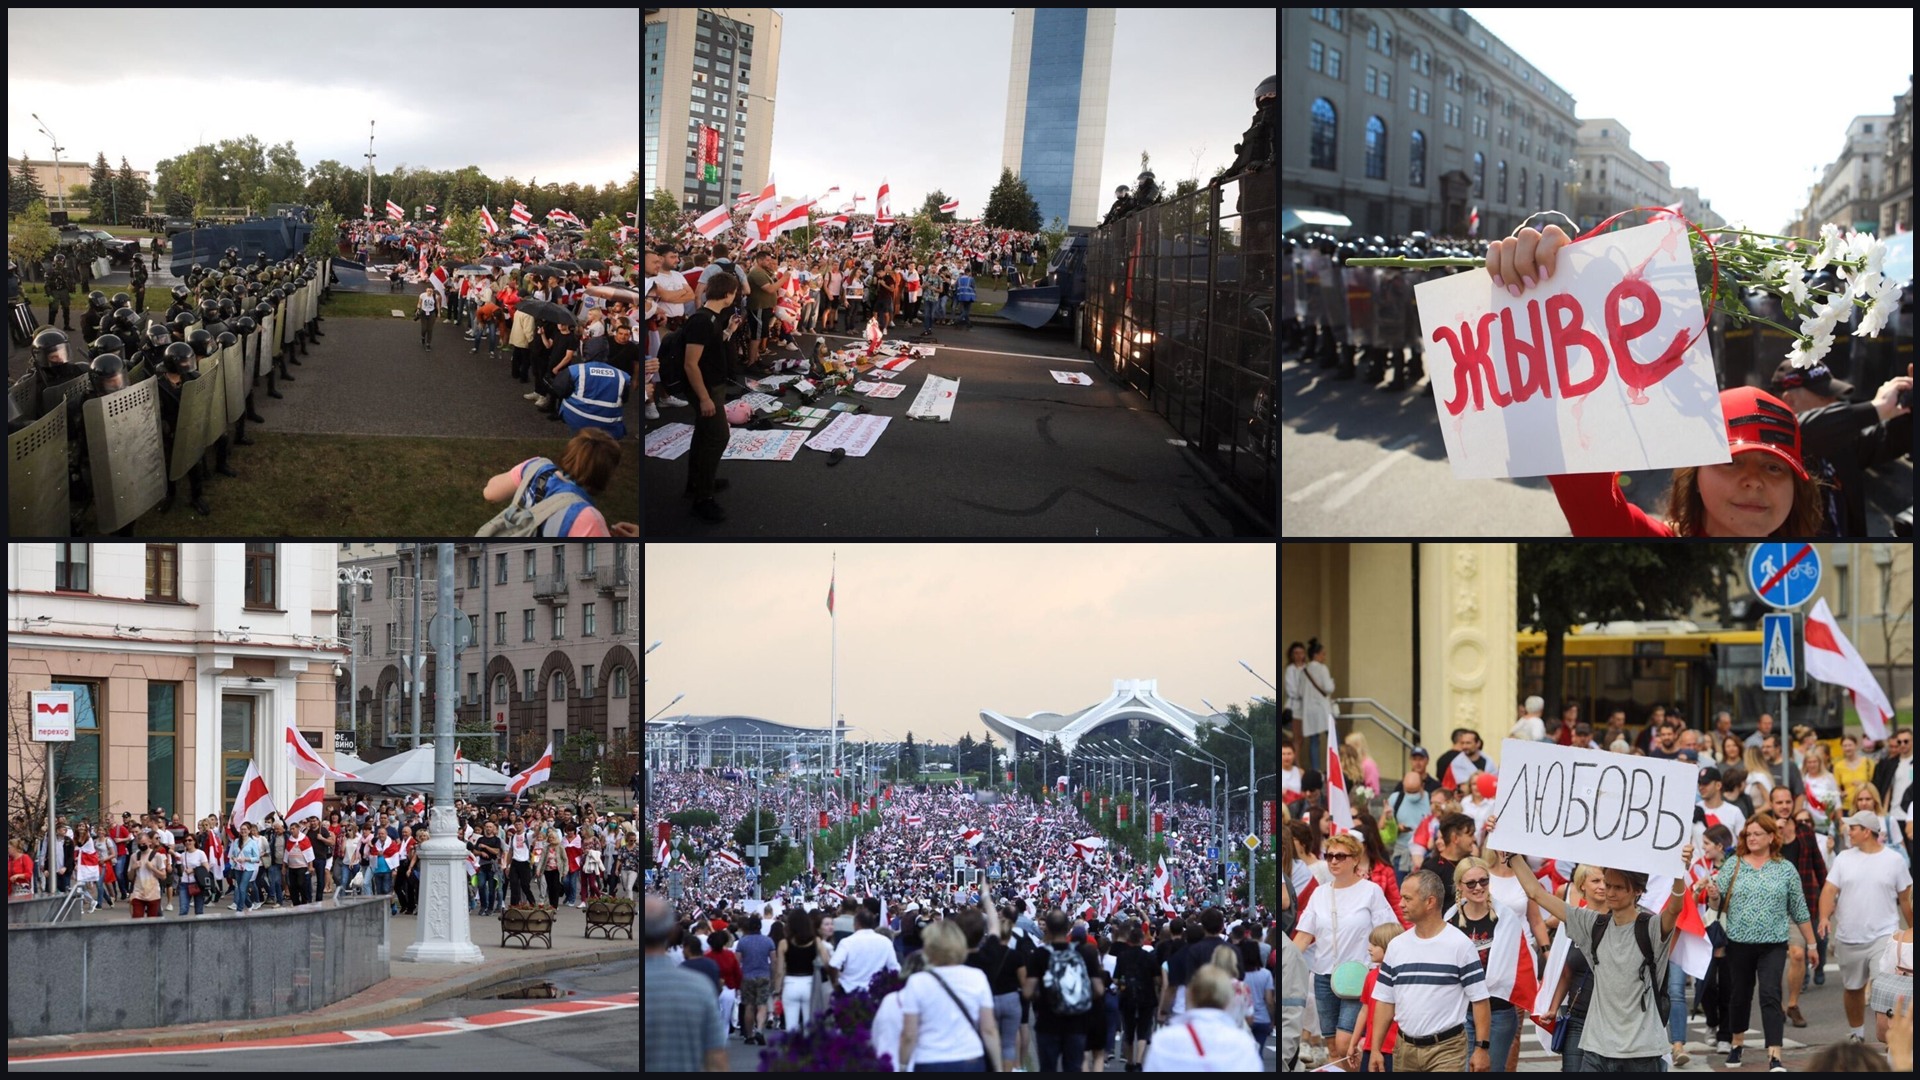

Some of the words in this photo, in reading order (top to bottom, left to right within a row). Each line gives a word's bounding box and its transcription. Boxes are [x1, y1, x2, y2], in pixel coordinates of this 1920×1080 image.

[590, 367, 614, 376] PRESS
[38, 729, 69, 737] переход
[336, 741, 354, 749] ВИНО
[1496, 761, 1685, 850] ЛЮБОВЬ
